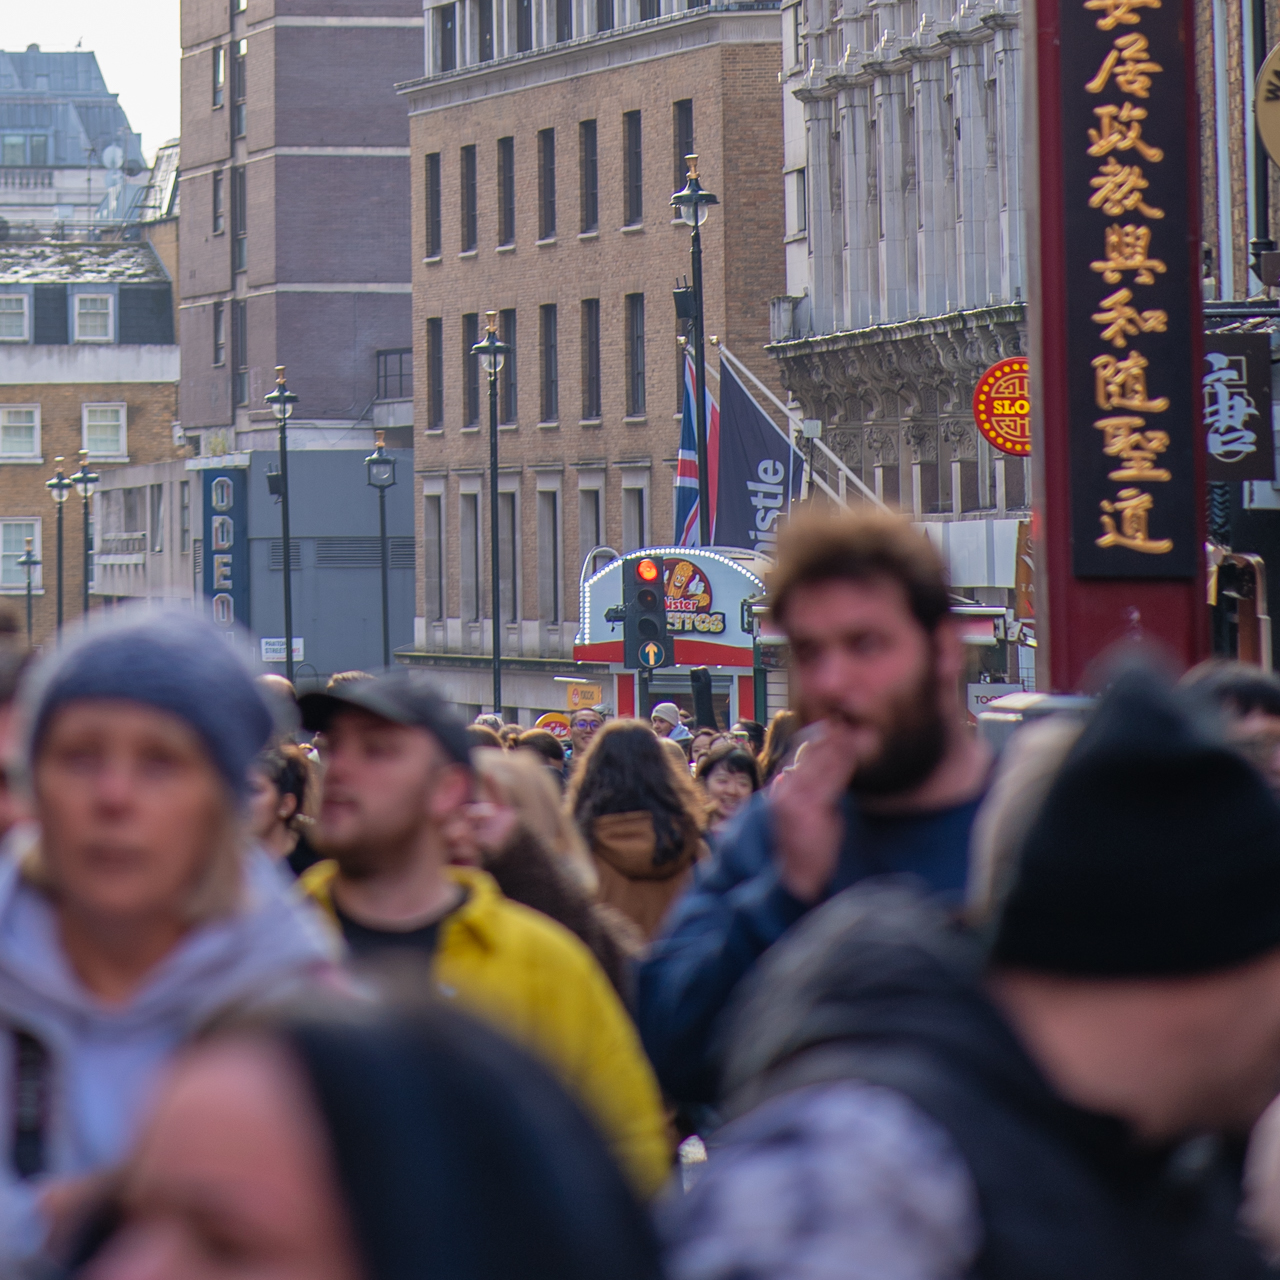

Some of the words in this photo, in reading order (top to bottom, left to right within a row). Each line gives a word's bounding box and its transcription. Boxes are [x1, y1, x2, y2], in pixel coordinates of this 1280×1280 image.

[992, 399, 1031, 415] SLO
[747, 459, 785, 552] istle
[211, 476, 234, 645] ODEO
